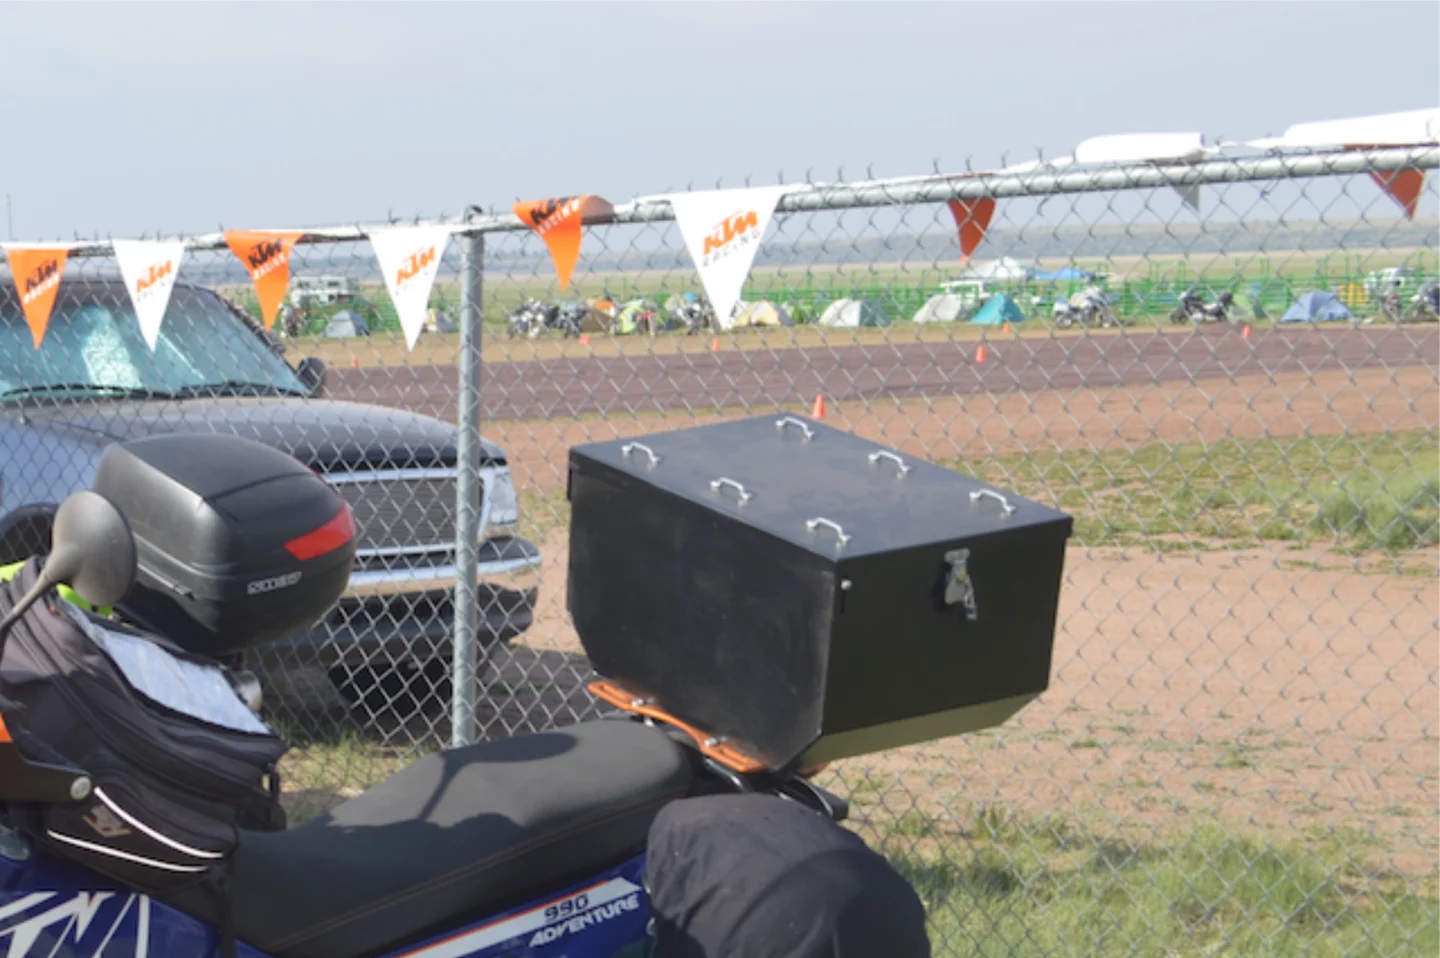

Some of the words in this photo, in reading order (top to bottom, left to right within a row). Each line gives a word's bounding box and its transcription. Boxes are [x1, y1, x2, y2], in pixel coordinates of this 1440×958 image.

[703, 210, 758, 255] KTM
[396, 246, 436, 286] KTM
[528, 894, 640, 948] ADVENTURE
